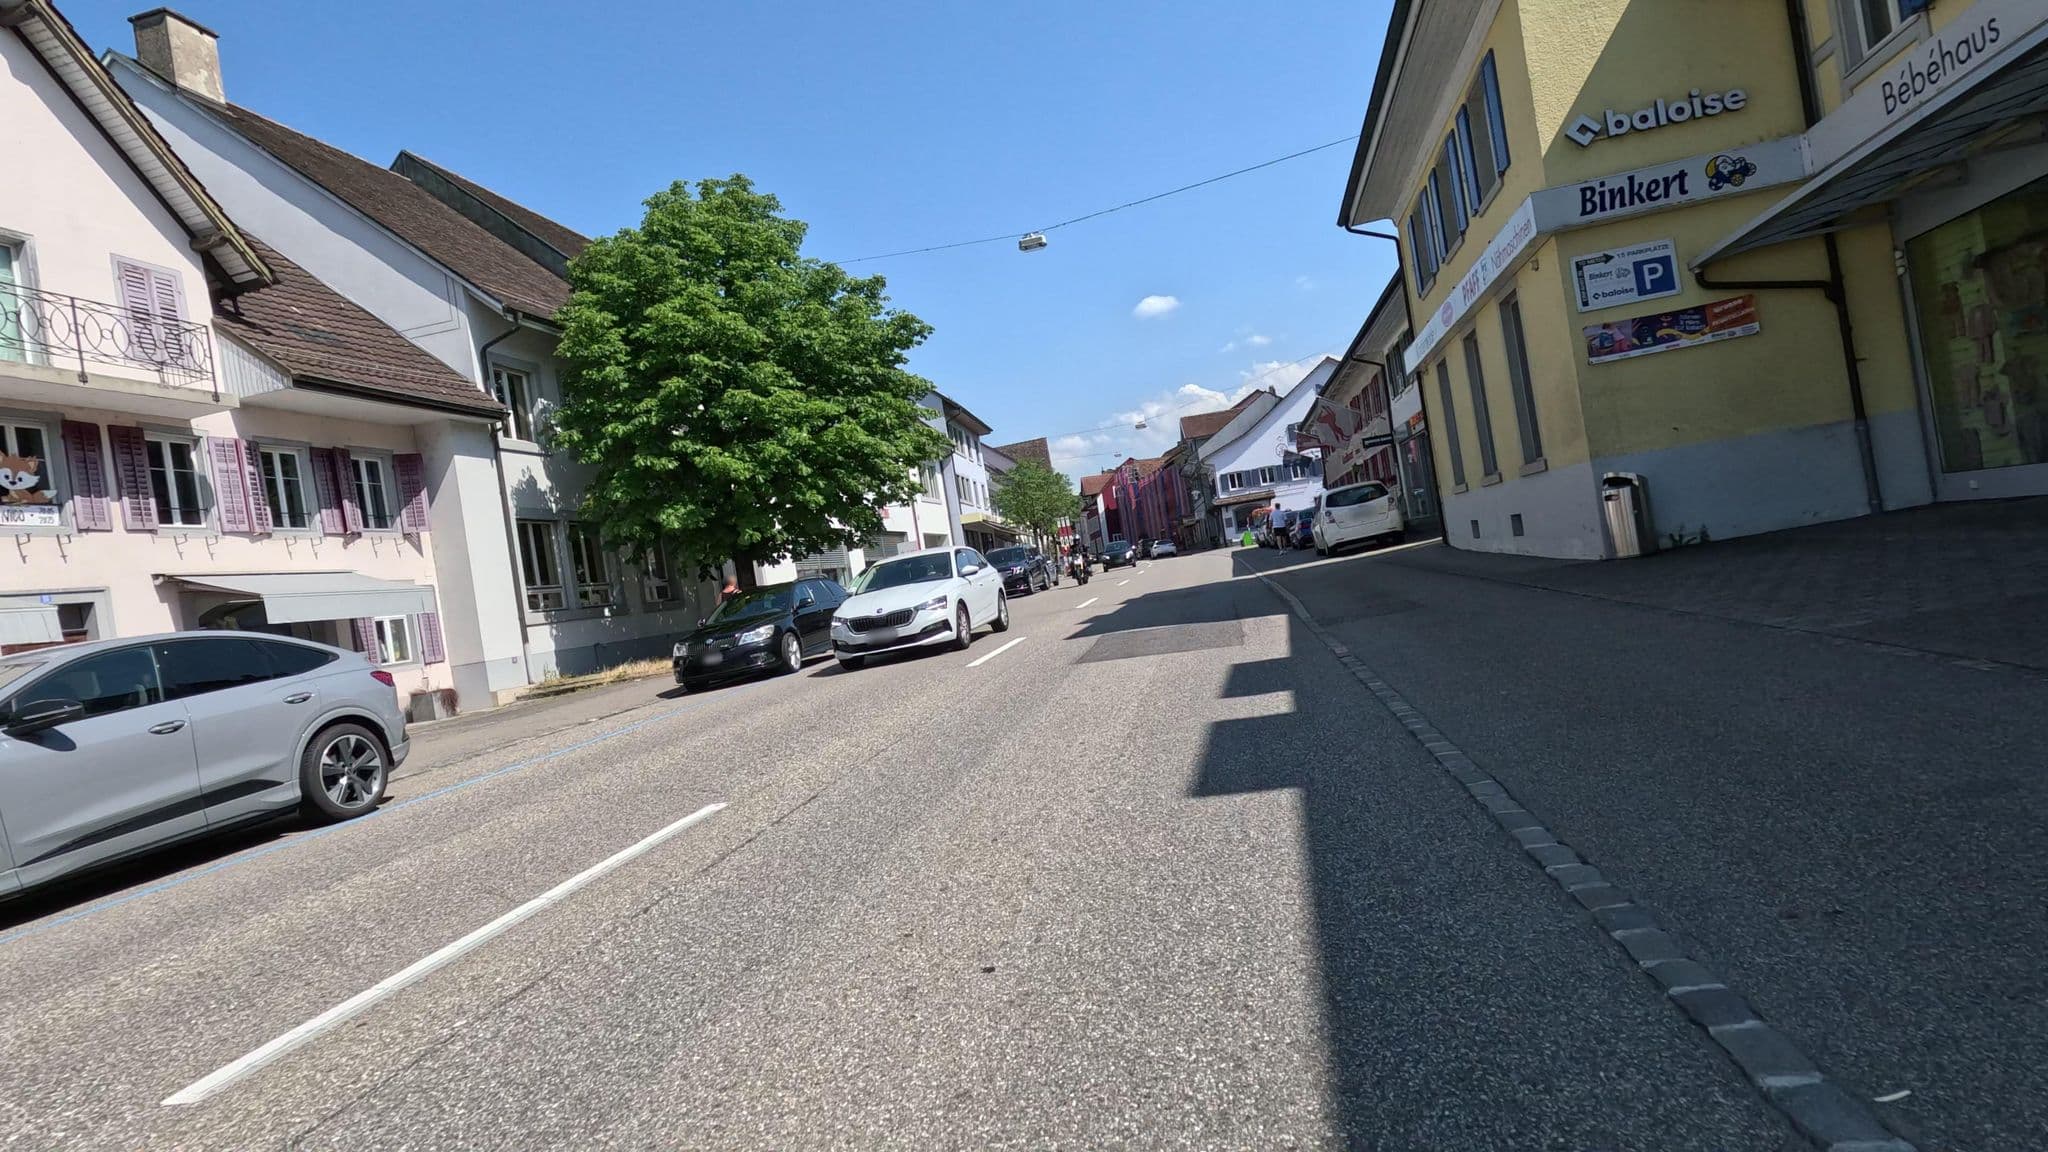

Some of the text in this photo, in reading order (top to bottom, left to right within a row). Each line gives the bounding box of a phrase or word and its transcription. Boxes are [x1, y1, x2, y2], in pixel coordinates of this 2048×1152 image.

[1881, 17, 2000, 116] Bébéhaus
[1604, 88, 1748, 137] baloise
[1579, 169, 1688, 217] Binkert
[1602, 287, 1634, 298] baloise
[1643, 263, 1663, 290] P
